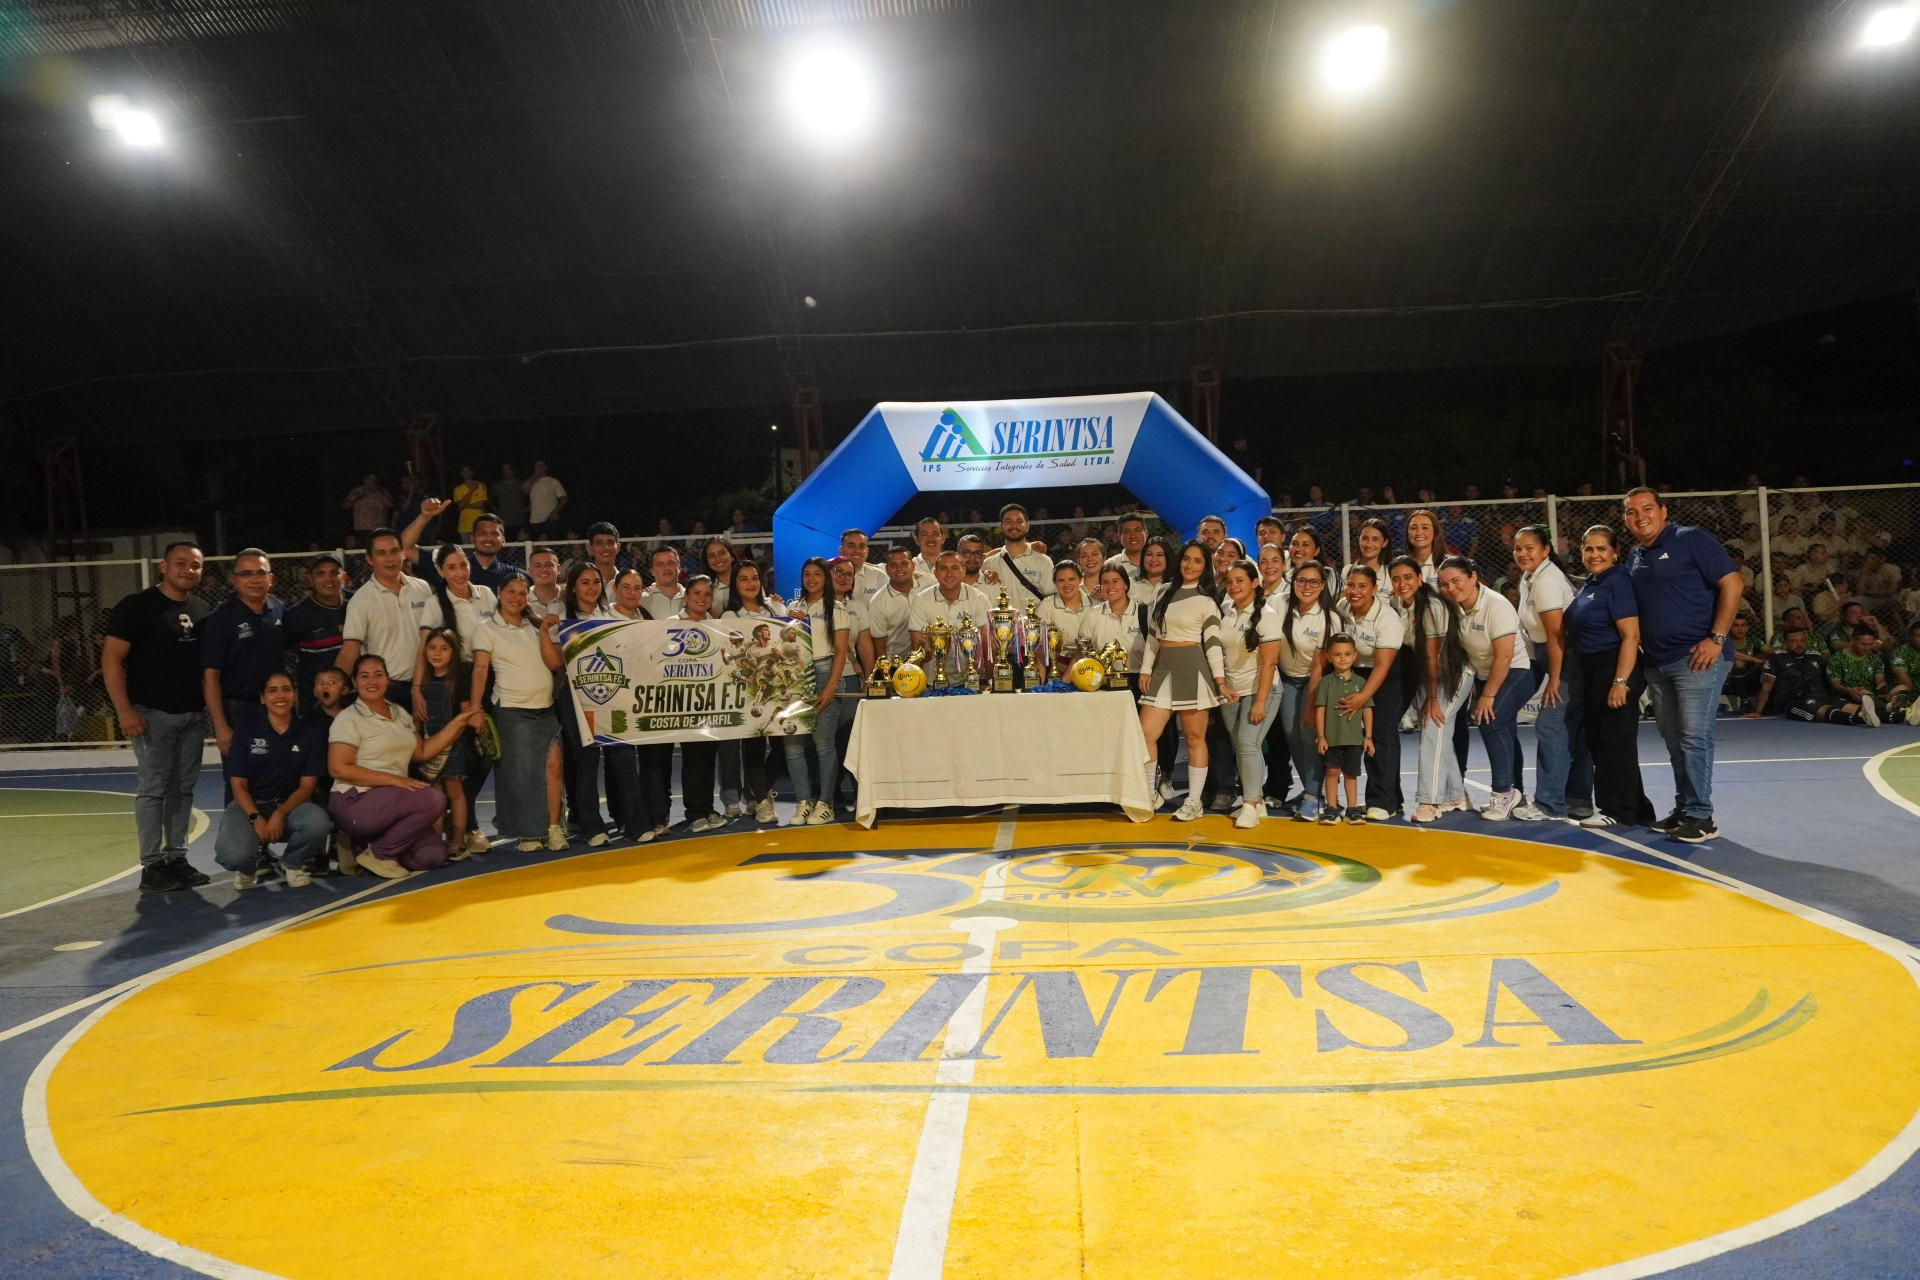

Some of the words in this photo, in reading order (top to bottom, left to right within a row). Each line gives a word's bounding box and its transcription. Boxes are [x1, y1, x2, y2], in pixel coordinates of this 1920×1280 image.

[991, 415, 1113, 455] SERINTSA
[923, 464, 941, 472] IPS
[954, 463, 991, 472] Servicios
[995, 461, 1032, 473] Integrales
[1035, 459, 1045, 469] de
[1048, 458, 1077, 469] Salud
[1084, 456, 1114, 466] LTDA.
[578, 673, 612, 684] SERINTSA
[613, 675, 623, 684] FC
[663, 663, 714, 678] SERINTSA
[632, 683, 716, 714] SERINTSA
[721, 681, 747, 710] F.C
[649, 717, 680, 729] COSTA
[682, 716, 696, 728] DE
[699, 714, 733, 726] MARFIL
[1004, 890, 1132, 901] años
[782, 938, 1181, 965] COPA
[322, 957, 1643, 1072] SERINTSA
